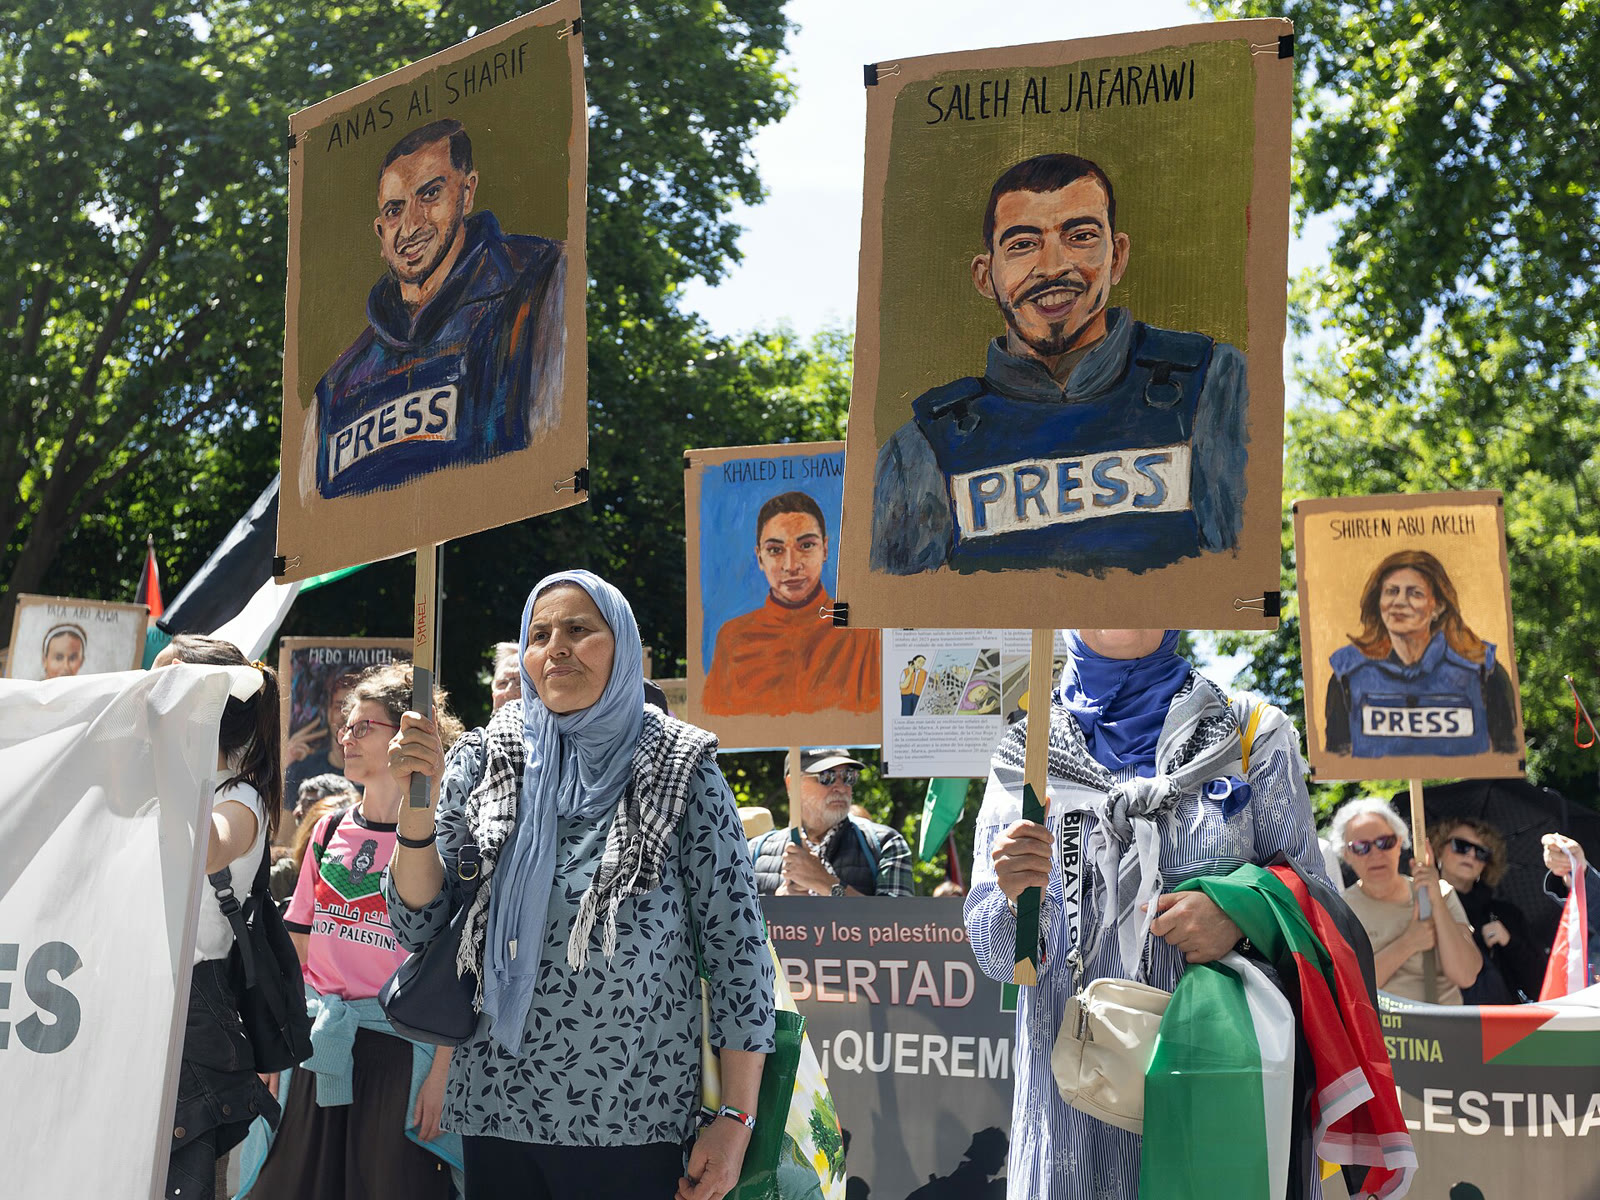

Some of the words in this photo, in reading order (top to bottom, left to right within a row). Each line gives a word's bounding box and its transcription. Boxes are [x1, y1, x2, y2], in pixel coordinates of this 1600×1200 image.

[327, 99, 394, 152] ANAS
[406, 84, 433, 121] AL
[445, 41, 529, 105] SHARIF
[926, 78, 1010, 125] SALEH
[1021, 76, 1051, 115] AL
[1059, 59, 1194, 112] JAFARAWI
[333, 390, 452, 473] PRESS
[723, 460, 776, 483] KHALED
[782, 459, 795, 480] EL
[967, 452, 1173, 532] PRESS
[1330, 516, 1391, 541] SHIREEN
[1397, 515, 1425, 535] ABU
[1431, 515, 1476, 535] AKLEH
[416, 594, 427, 648] ISMAEL
[309, 648, 342, 665] MEDO
[1371, 709, 1459, 734] PRESS
[320, 921, 336, 935] OF
[339, 925, 397, 952] PALESTINE
[814, 924, 825, 947] y
[831, 921, 862, 942] los
[780, 957, 976, 1008] BERTAD
[1380, 1014, 1402, 1029] on
[821, 1029, 1015, 1080] ¡QUEREM
